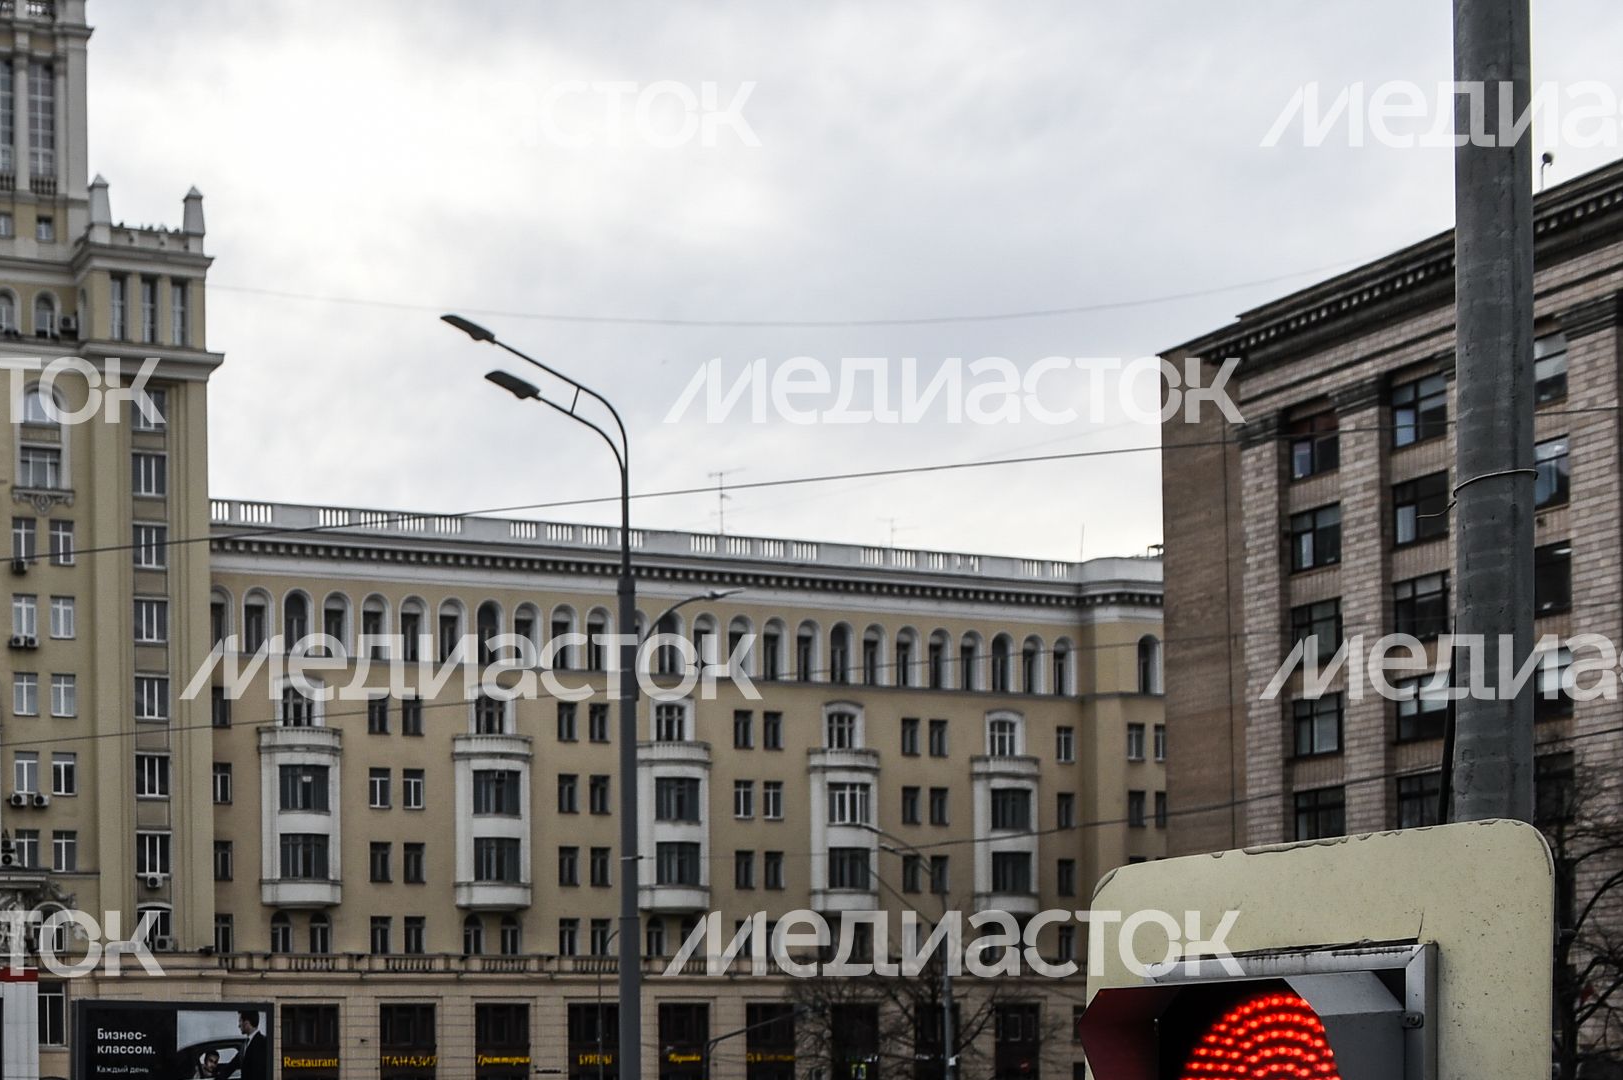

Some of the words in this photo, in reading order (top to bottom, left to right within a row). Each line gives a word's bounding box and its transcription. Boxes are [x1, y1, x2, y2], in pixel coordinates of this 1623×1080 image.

[97, 1028, 147, 1040] Бизнес-
[97, 1045, 156, 1055] классом.
[283, 1056, 338, 1068] Restaurant
[97, 1065, 128, 1073] Каждый
